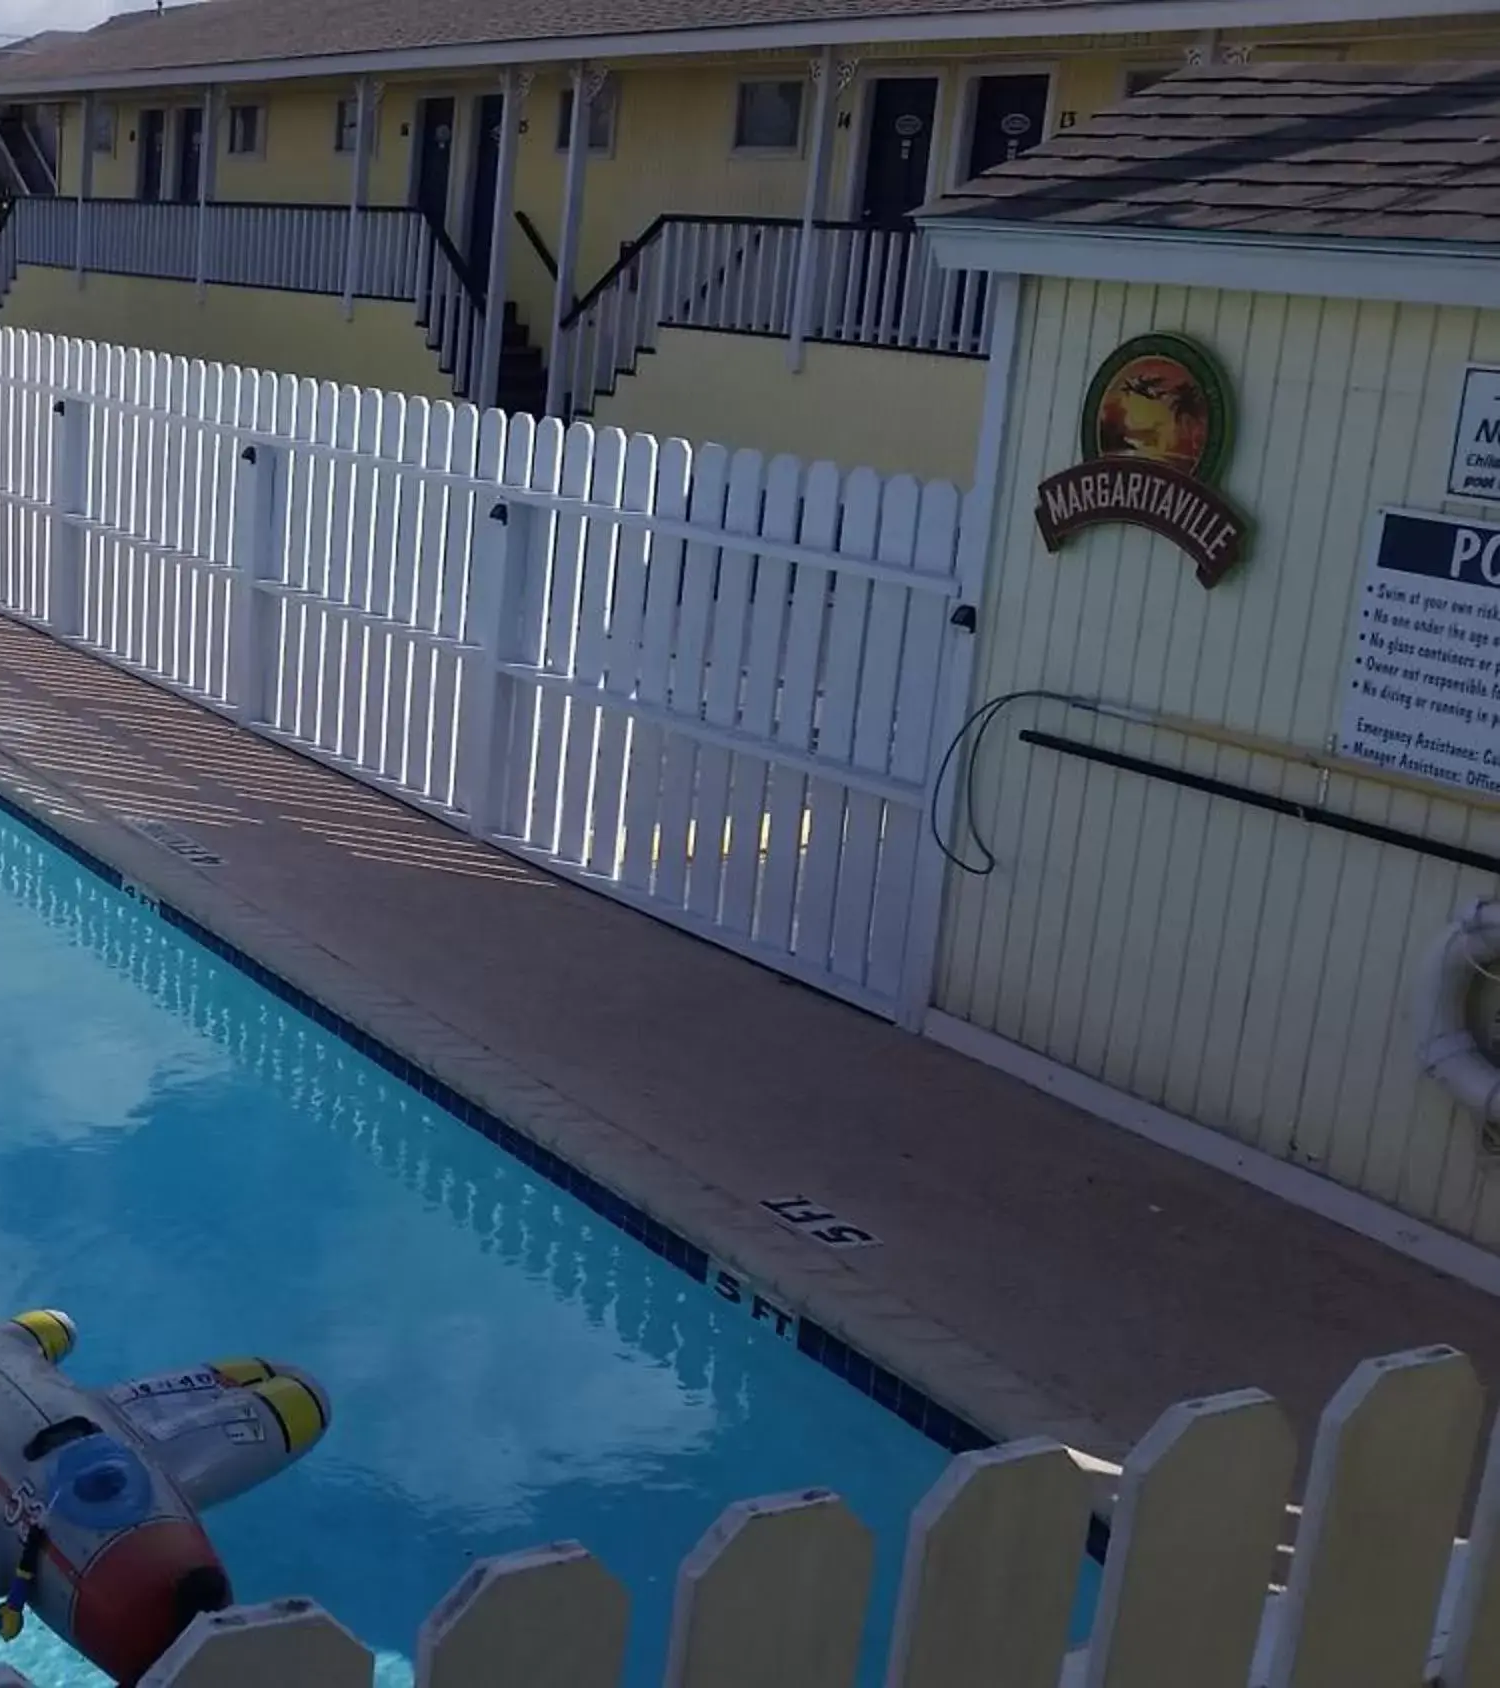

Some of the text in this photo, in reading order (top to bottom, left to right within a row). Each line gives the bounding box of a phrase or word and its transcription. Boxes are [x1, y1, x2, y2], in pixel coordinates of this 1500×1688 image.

[1046, 471, 1237, 561] MARGARITAVILLE
[1377, 583, 1405, 602] Swim
[1409, 591, 1420, 605] at
[1423, 597, 1448, 613] your
[1452, 602, 1473, 615] own
[1374, 608, 1388, 624] No
[1392, 616, 1411, 629] one
[1414, 618, 1445, 635] under
[1448, 622, 1466, 640] the
[1469, 631, 1488, 648] age
[1369, 631, 1384, 648] No
[1387, 637, 1415, 655] glass
[1418, 646, 1475, 668] containers
[1479, 659, 1492, 671] or
[1367, 655, 1399, 675] Owner
[1402, 668, 1420, 681] not
[1423, 673, 1487, 697] responsible
[1363, 680, 1377, 697] No
[1381, 685, 1412, 710] diving
[1430, 699, 1473, 723] running
[1477, 706, 1488, 721] in
[1357, 716, 1412, 748] Emergency
[1415, 731, 1478, 761] Assistance:
[1354, 741, 1396, 767] Manager
[1400, 753, 1461, 783] Assistance:
[811, 1226, 874, 1244] 5
[713, 1270, 742, 1304] 5
